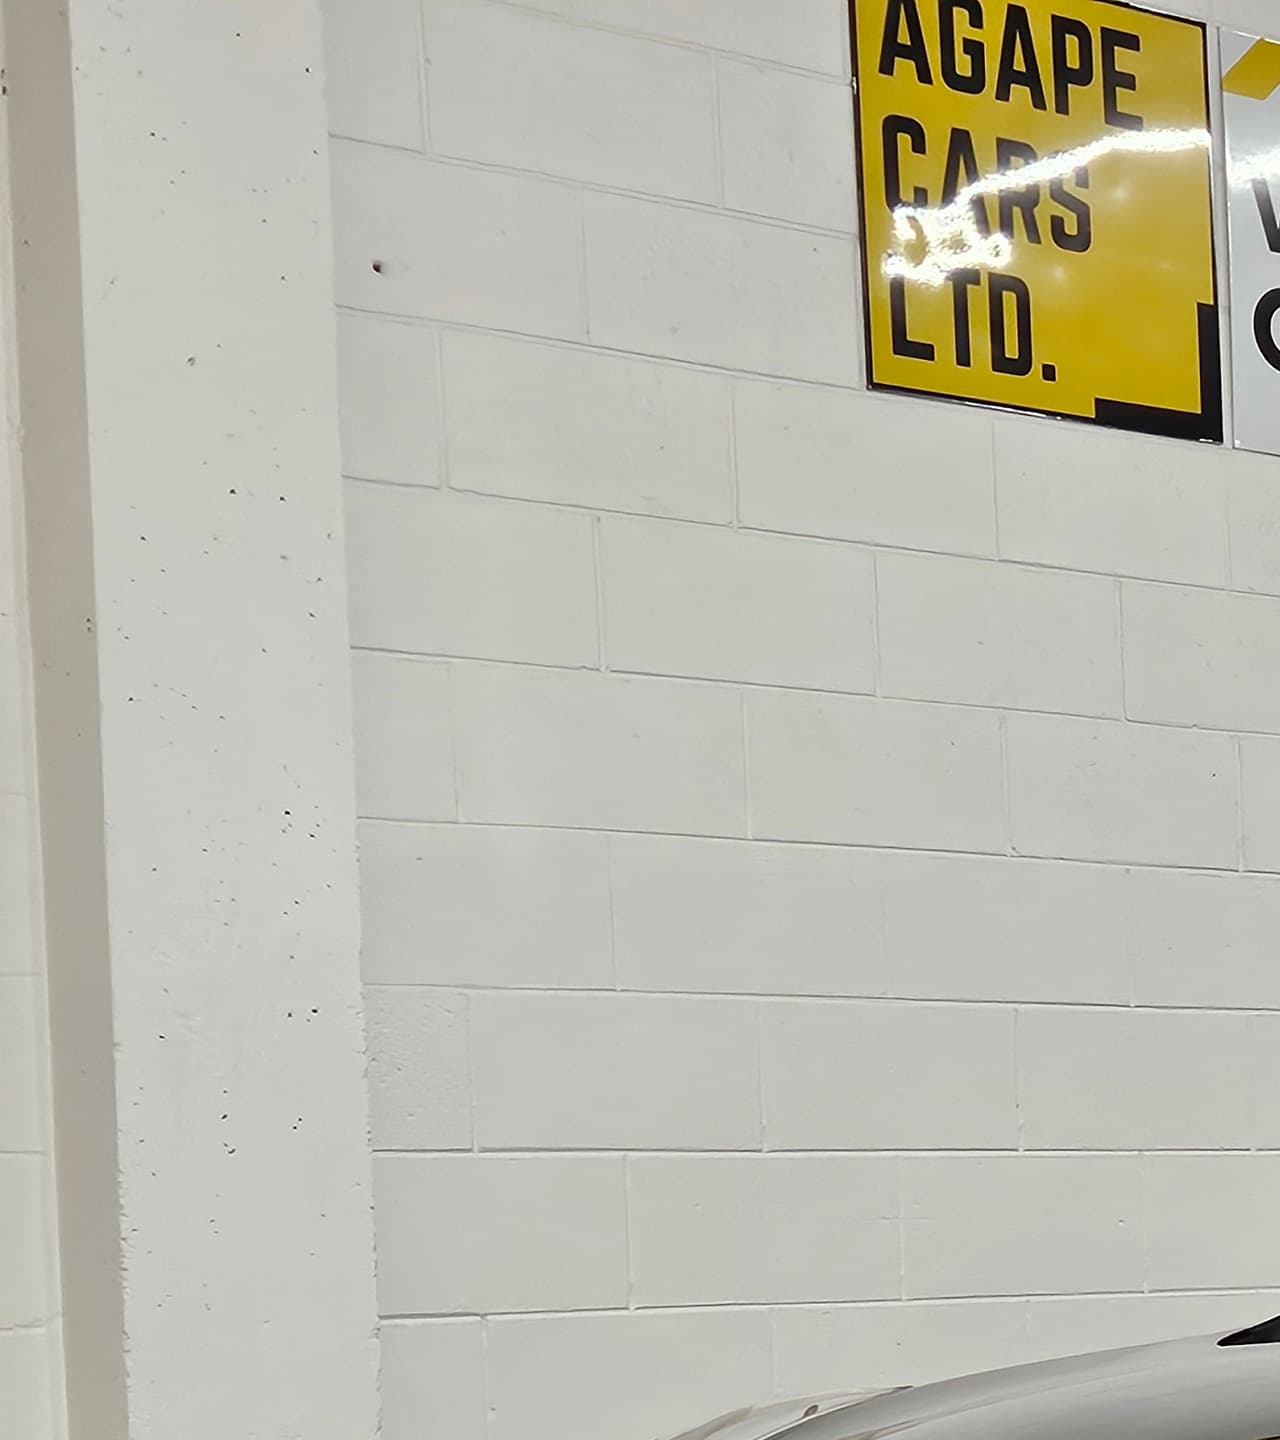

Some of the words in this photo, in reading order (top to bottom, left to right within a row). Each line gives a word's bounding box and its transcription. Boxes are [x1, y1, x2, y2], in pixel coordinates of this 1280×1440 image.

[878, 0, 1144, 130] AGAPE
[881, 113, 1092, 253] CARS
[887, 260, 1057, 383] LTD.
